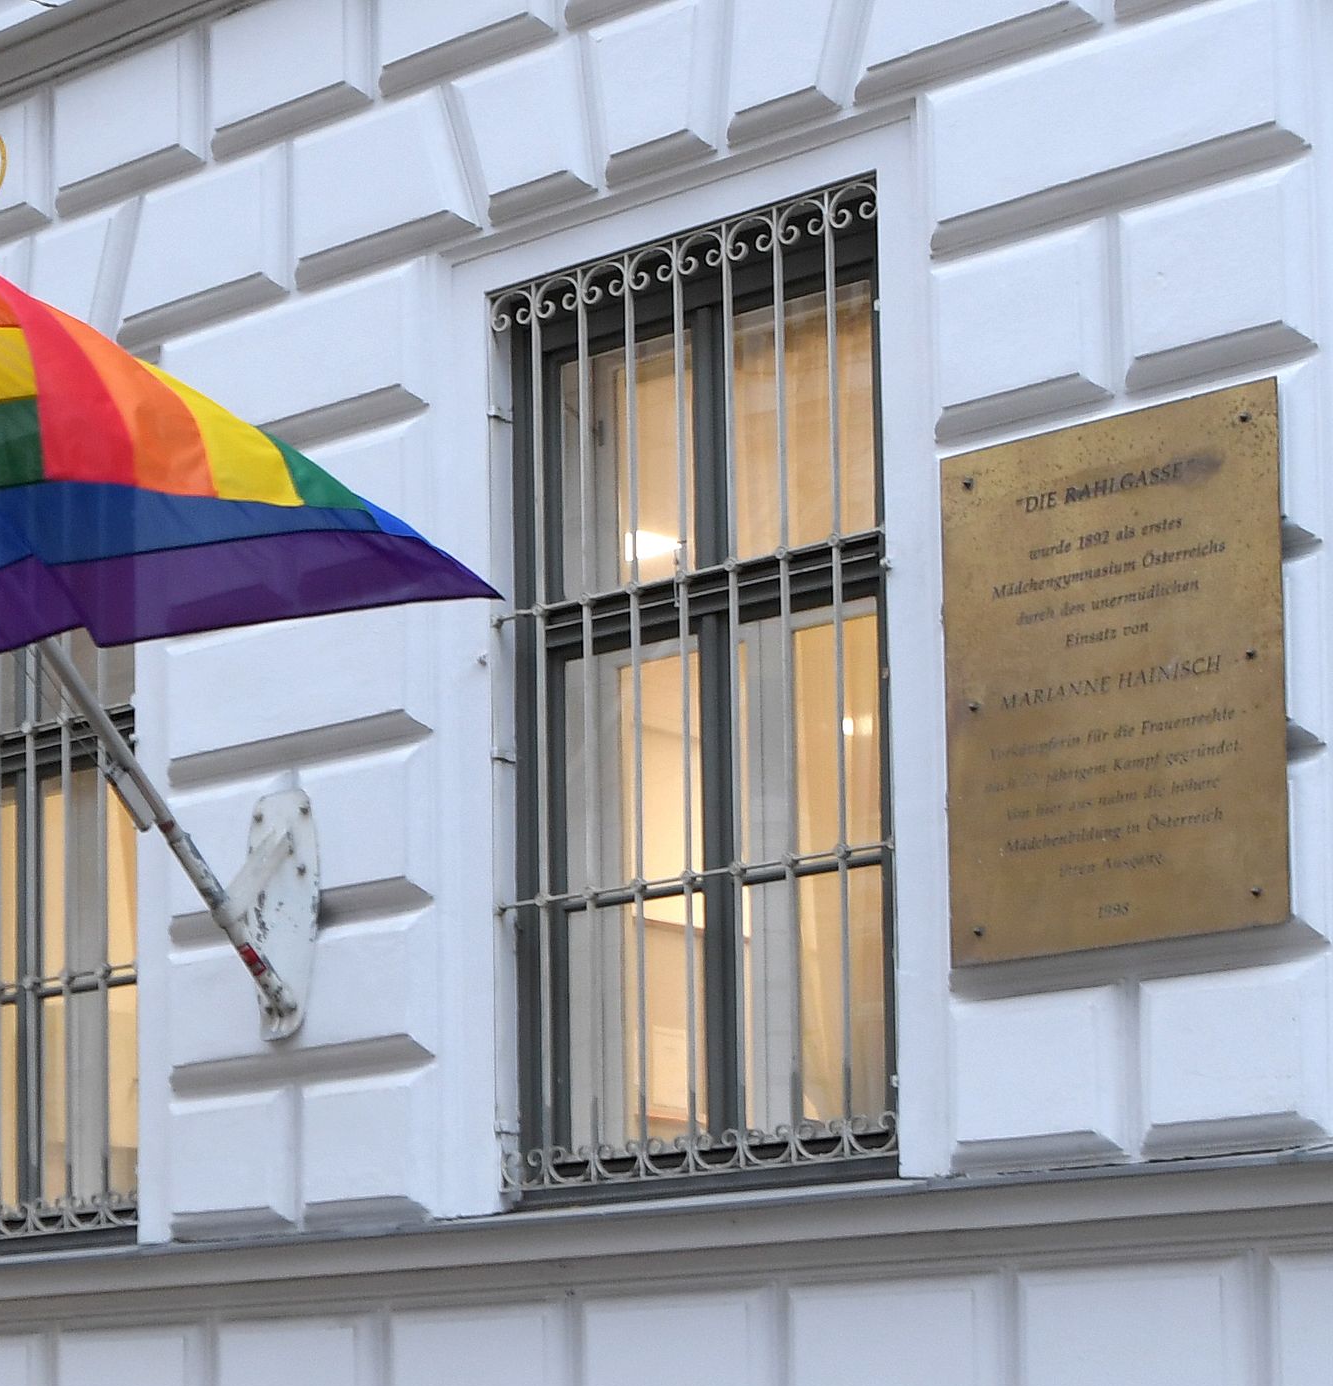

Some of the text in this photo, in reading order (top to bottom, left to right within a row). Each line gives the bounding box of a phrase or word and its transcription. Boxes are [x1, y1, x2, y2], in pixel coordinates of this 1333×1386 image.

[1029, 517, 1183, 561] wurde 1892 als erstes
[991, 538, 1226, 600] Mädchengymnasium Österreichs
[1016, 577, 1200, 626] durch den unermüdlichen
[1064, 621, 1150, 649] Einsatz von
[1001, 654, 1222, 711] MARIANNE HAINISCH
[1087, 726, 1110, 746] für
[1113, 723, 1135, 740] die
[1112, 751, 1161, 773] Kampf
[1143, 783, 1167, 800] die
[1125, 821, 1141, 835] in
[1146, 805, 1224, 833] Österreich
